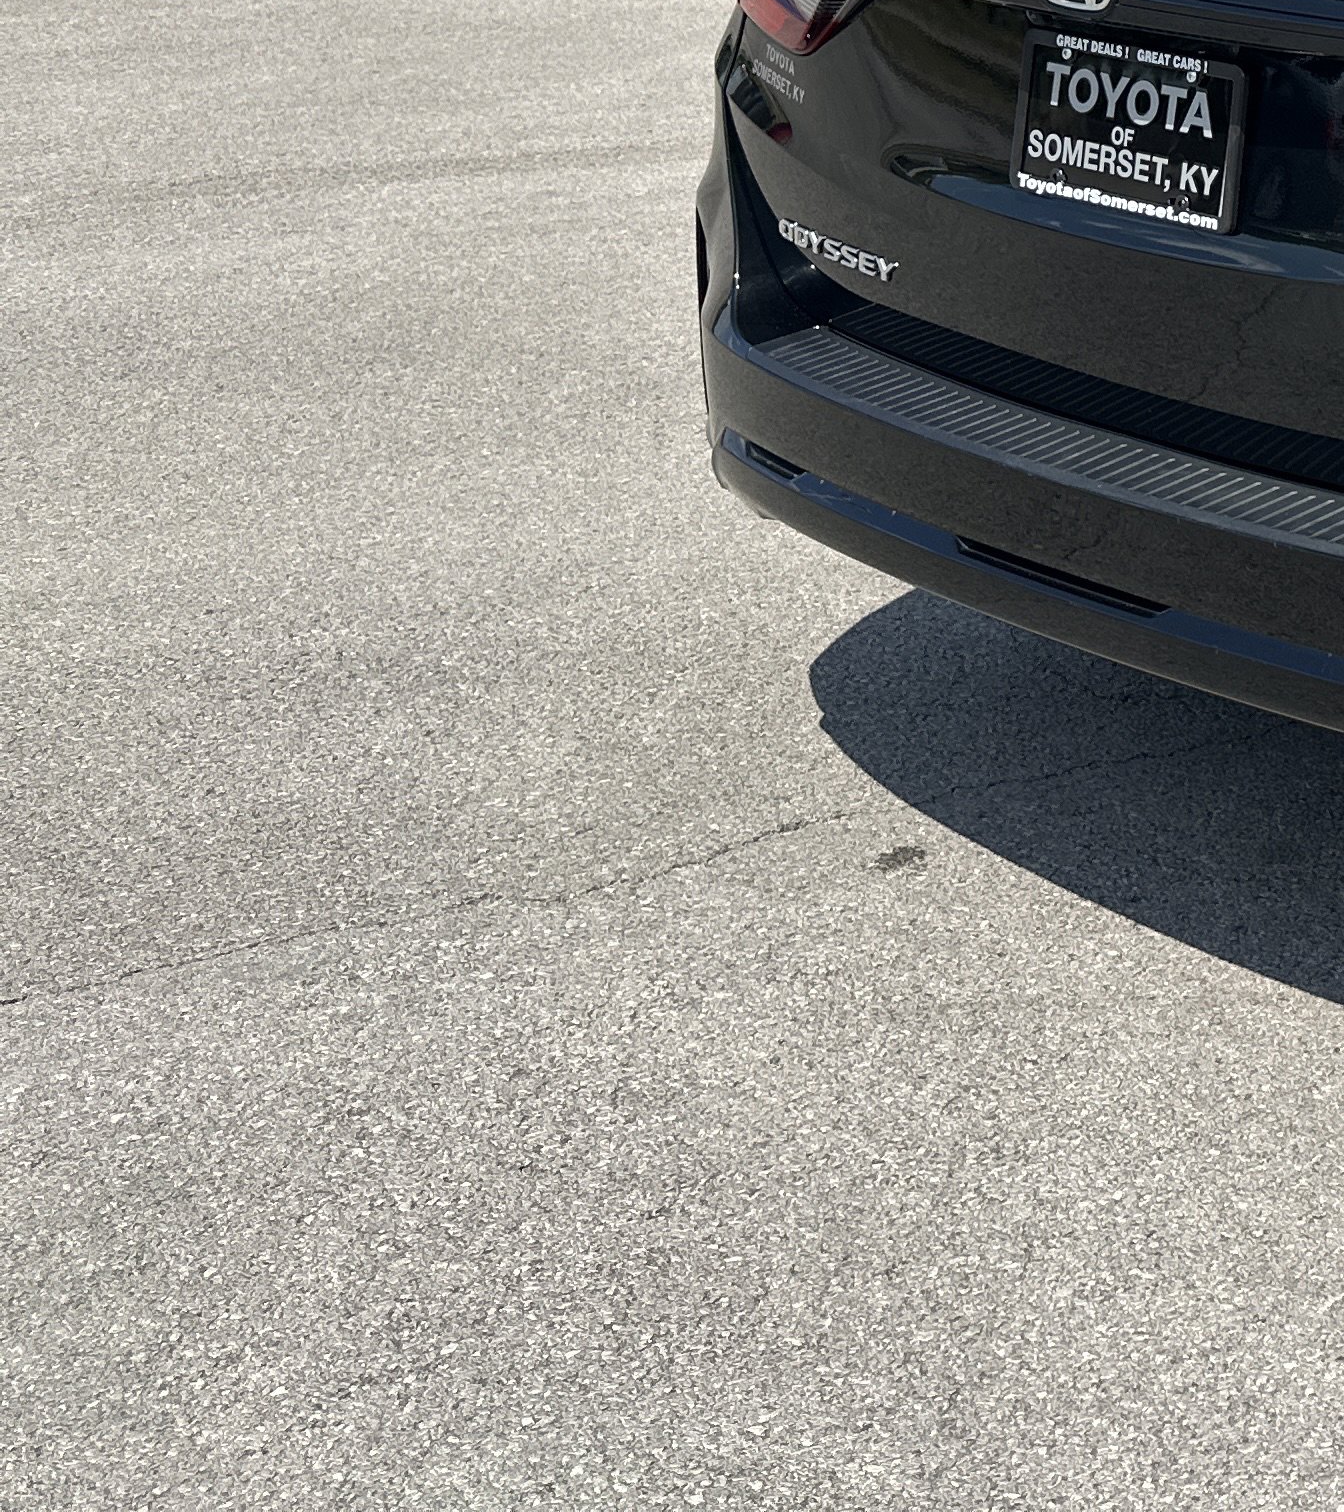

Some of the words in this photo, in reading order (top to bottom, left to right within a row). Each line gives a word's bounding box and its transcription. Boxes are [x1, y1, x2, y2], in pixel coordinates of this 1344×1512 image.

[765, 43, 795, 76] TOYOTA
[1056, 34, 1089, 52] GREAT
[1137, 48, 1171, 68] GREAT
[1046, 61, 1213, 139] TOYOTA
[1027, 129, 1169, 192] SOMERSET,
[1179, 160, 1219, 196] KY
[1111, 126, 1135, 147] OF
[1017, 171, 1219, 230] ToyotaofSomerset.com
[778, 218, 899, 281] ODYSSEY
